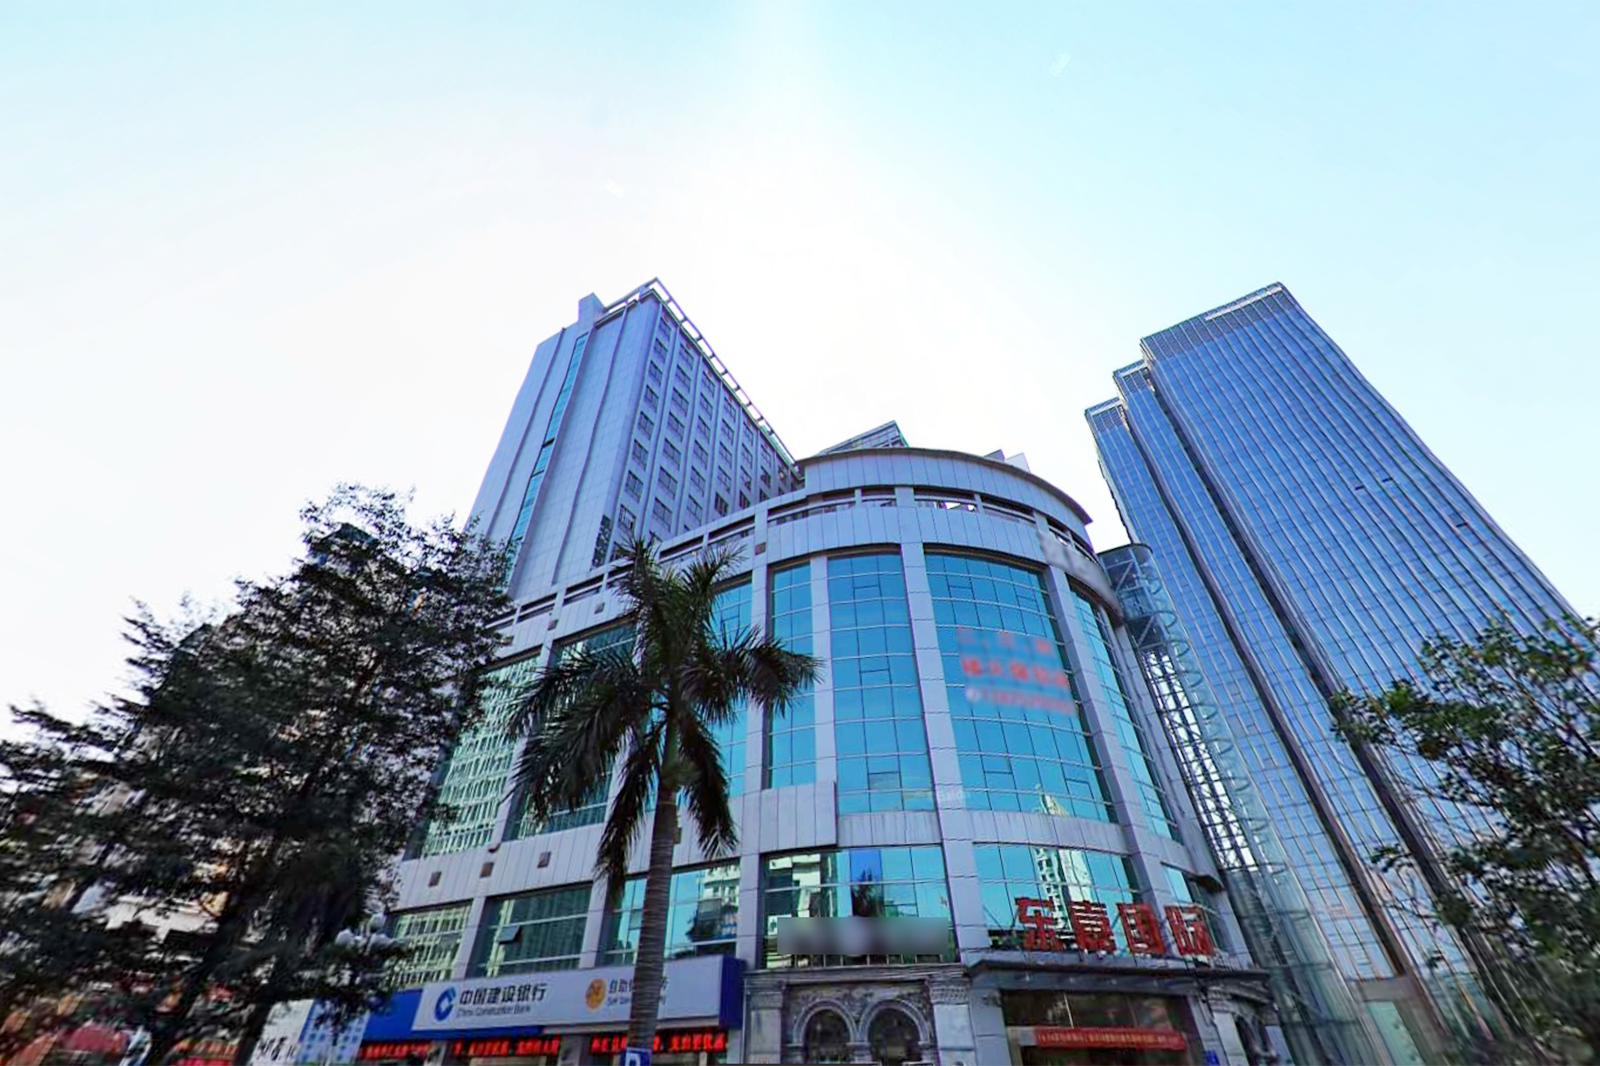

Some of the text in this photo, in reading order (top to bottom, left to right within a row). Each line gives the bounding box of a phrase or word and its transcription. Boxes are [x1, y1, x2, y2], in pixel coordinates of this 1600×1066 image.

[460, 983, 547, 1005] 中国建设银行
